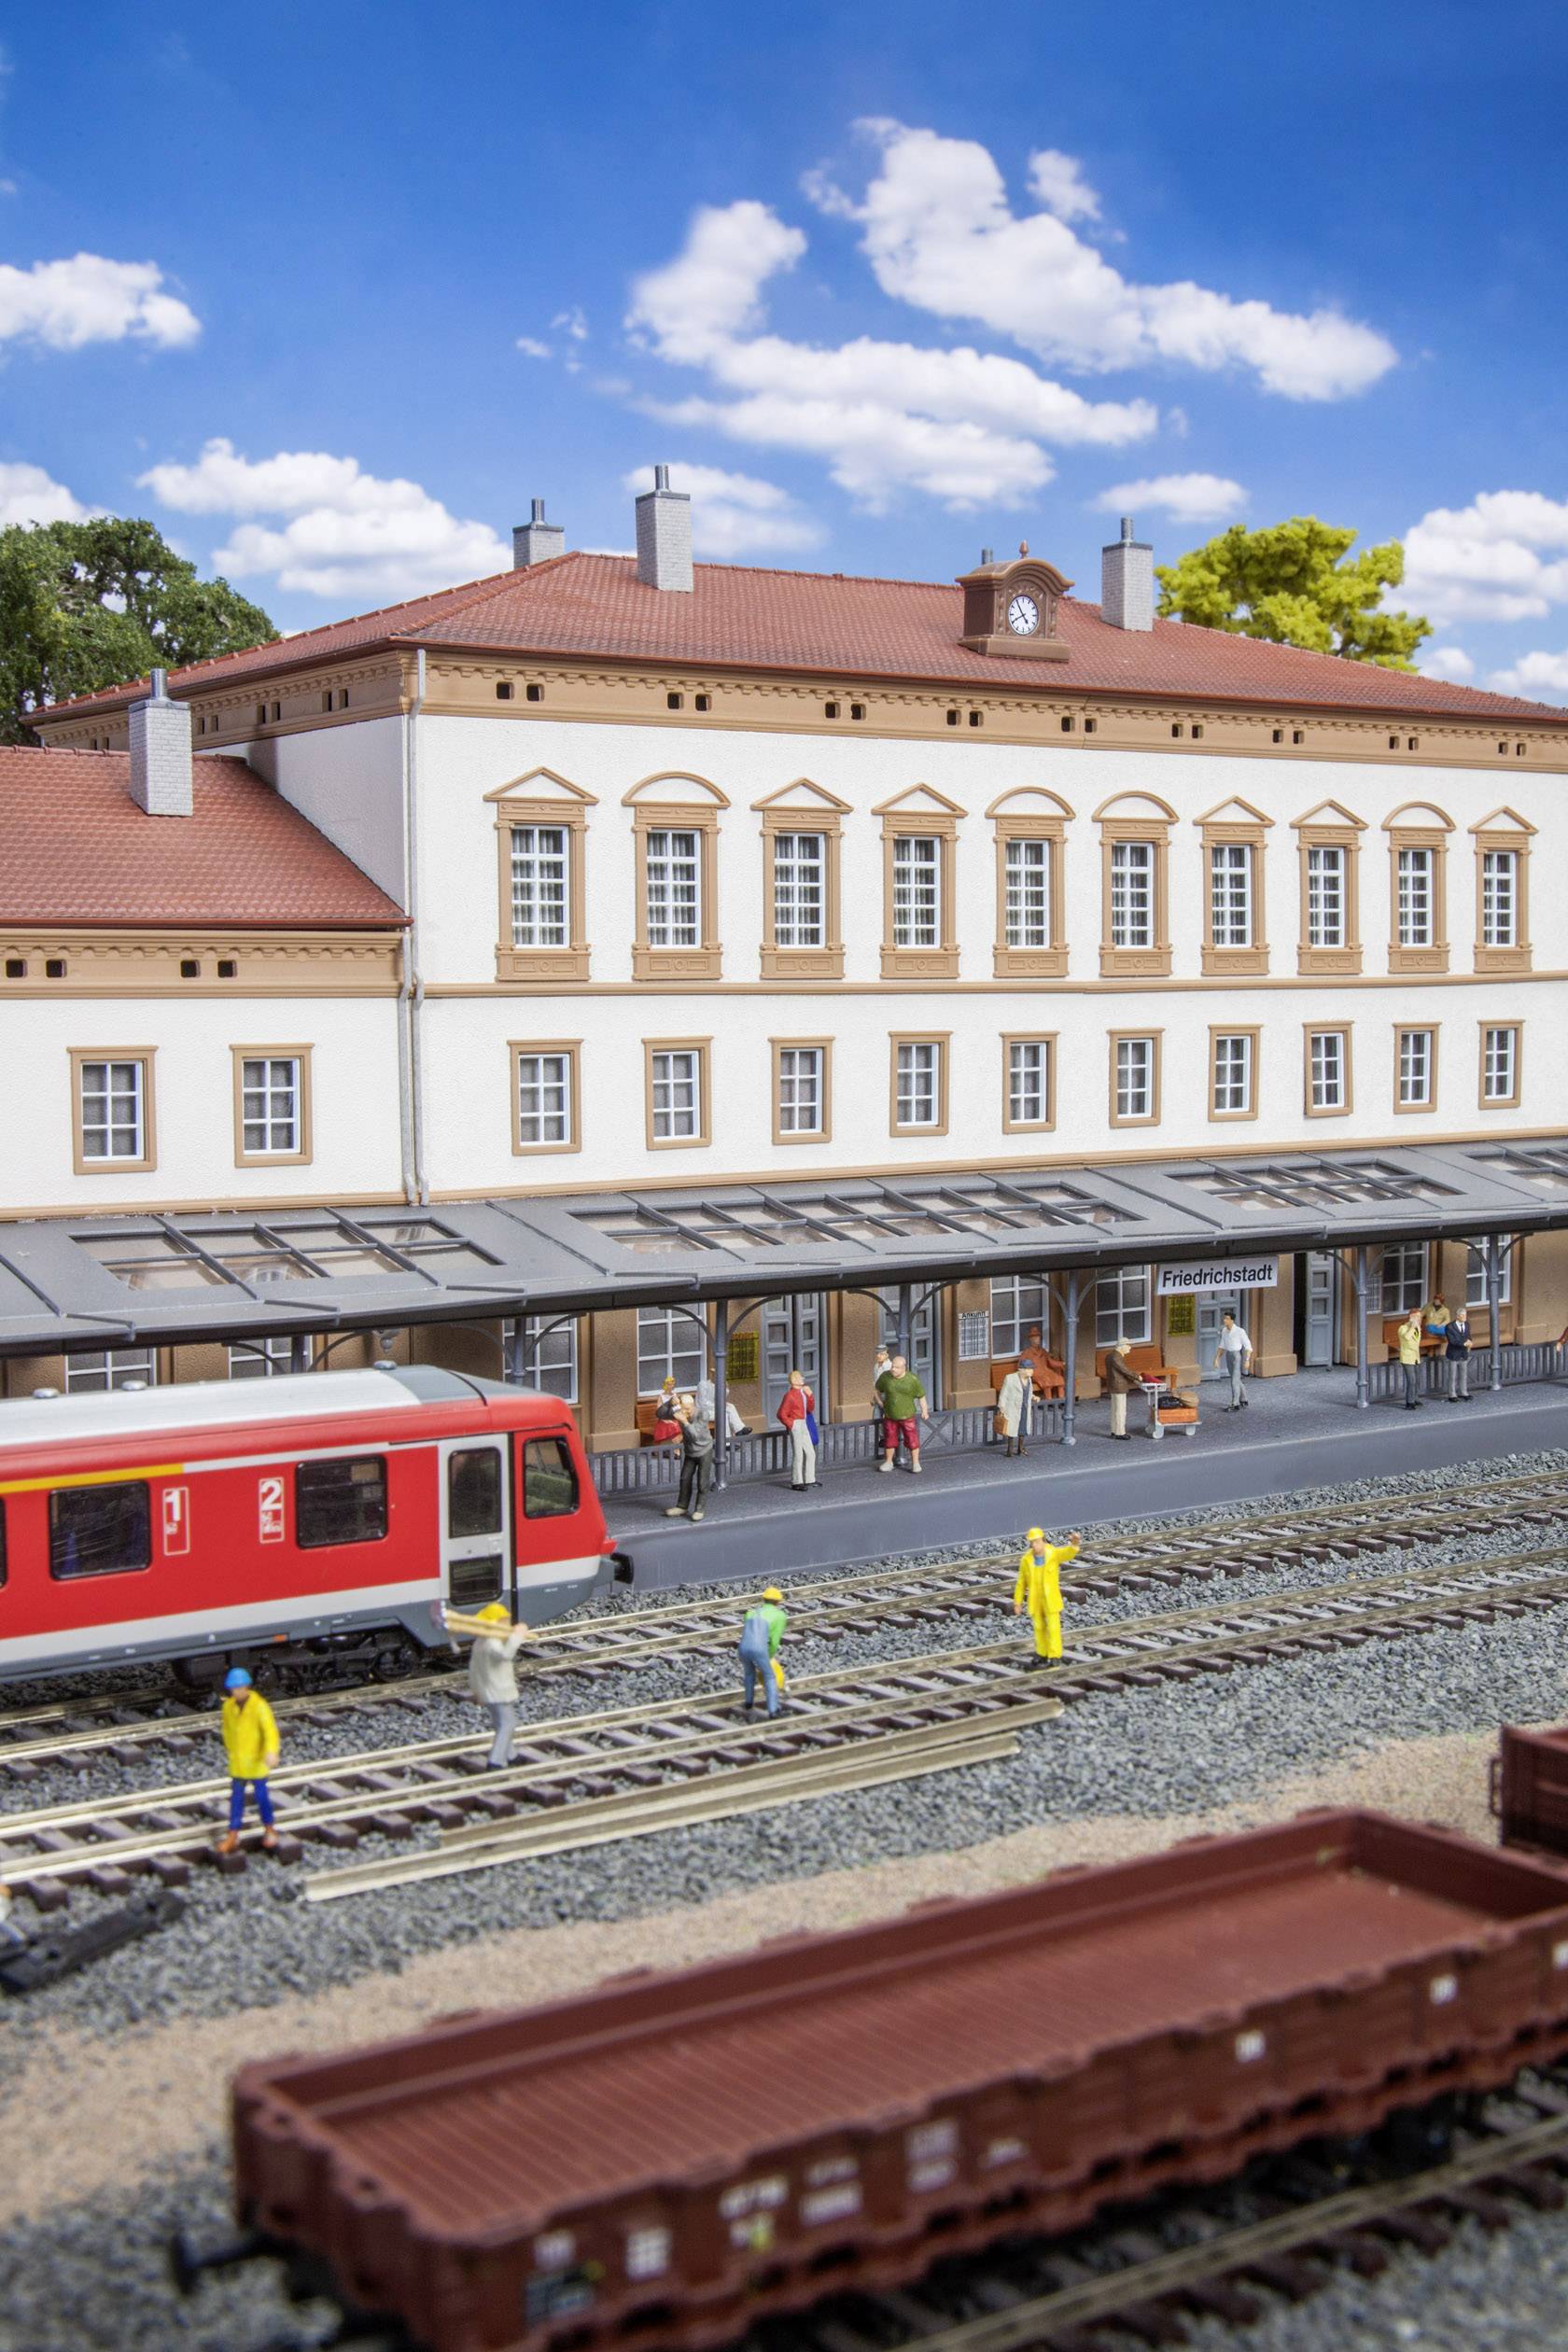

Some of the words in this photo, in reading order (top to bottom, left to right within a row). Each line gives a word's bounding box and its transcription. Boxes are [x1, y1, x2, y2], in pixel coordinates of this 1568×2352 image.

[1162, 1264, 1273, 1287] Friedrichstadt
[165, 1489, 180, 1521] 1
[260, 1479, 283, 1511] 2
